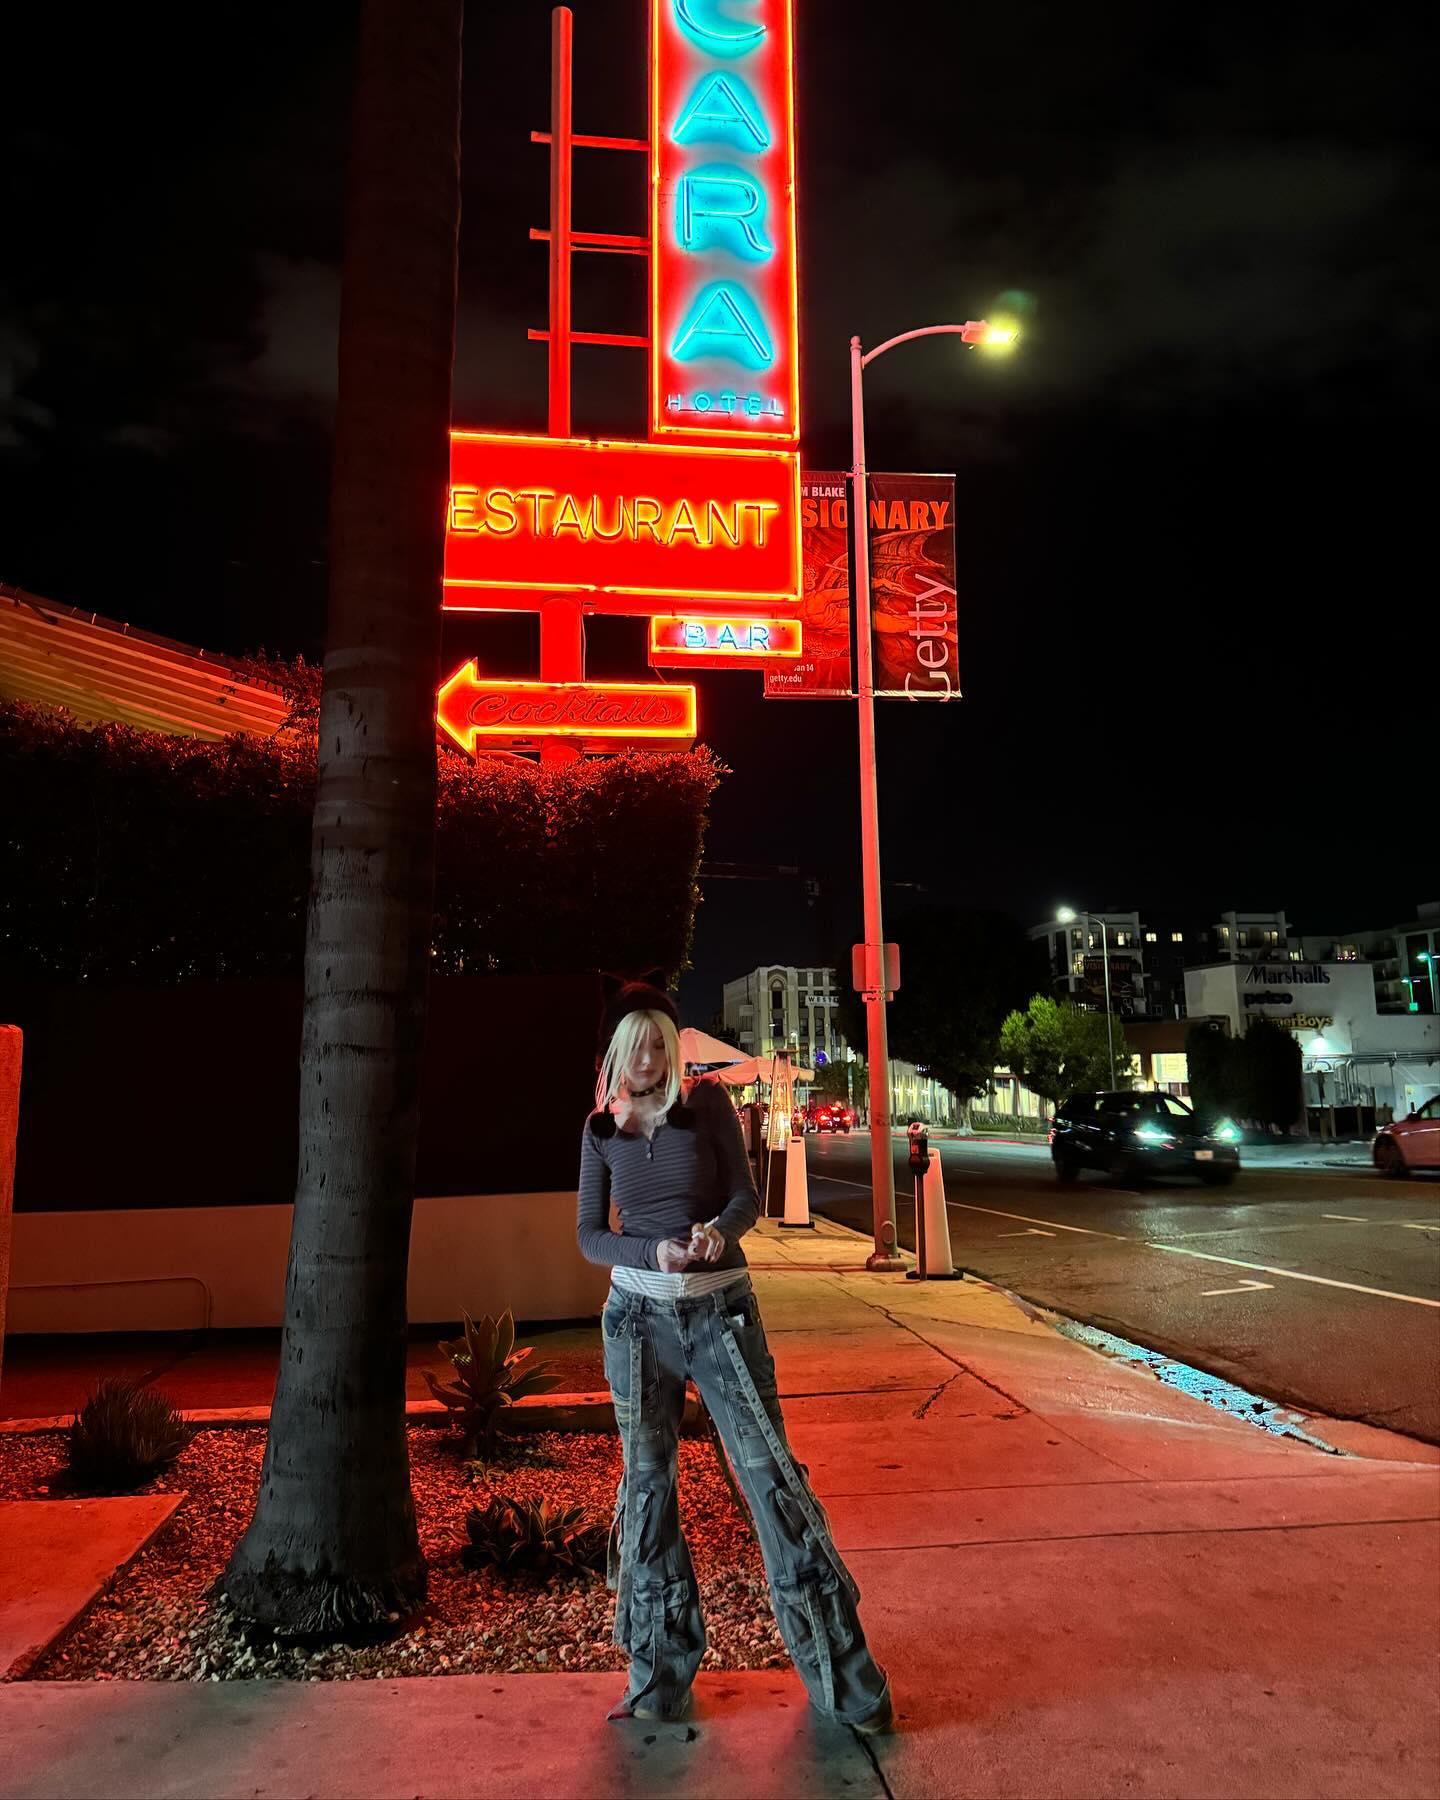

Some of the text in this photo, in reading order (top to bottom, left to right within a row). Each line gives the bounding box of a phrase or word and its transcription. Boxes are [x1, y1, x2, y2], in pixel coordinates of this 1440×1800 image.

[667, 394, 784, 416] HOTEL
[811, 486, 845, 498] BLAKE
[684, 623, 768, 650] BAR
[905, 573, 957, 702] Getty
[769, 673, 802, 684] getty.edu
[467, 693, 681, 727] Cocktails
[1245, 965, 1331, 984] Marshalls
